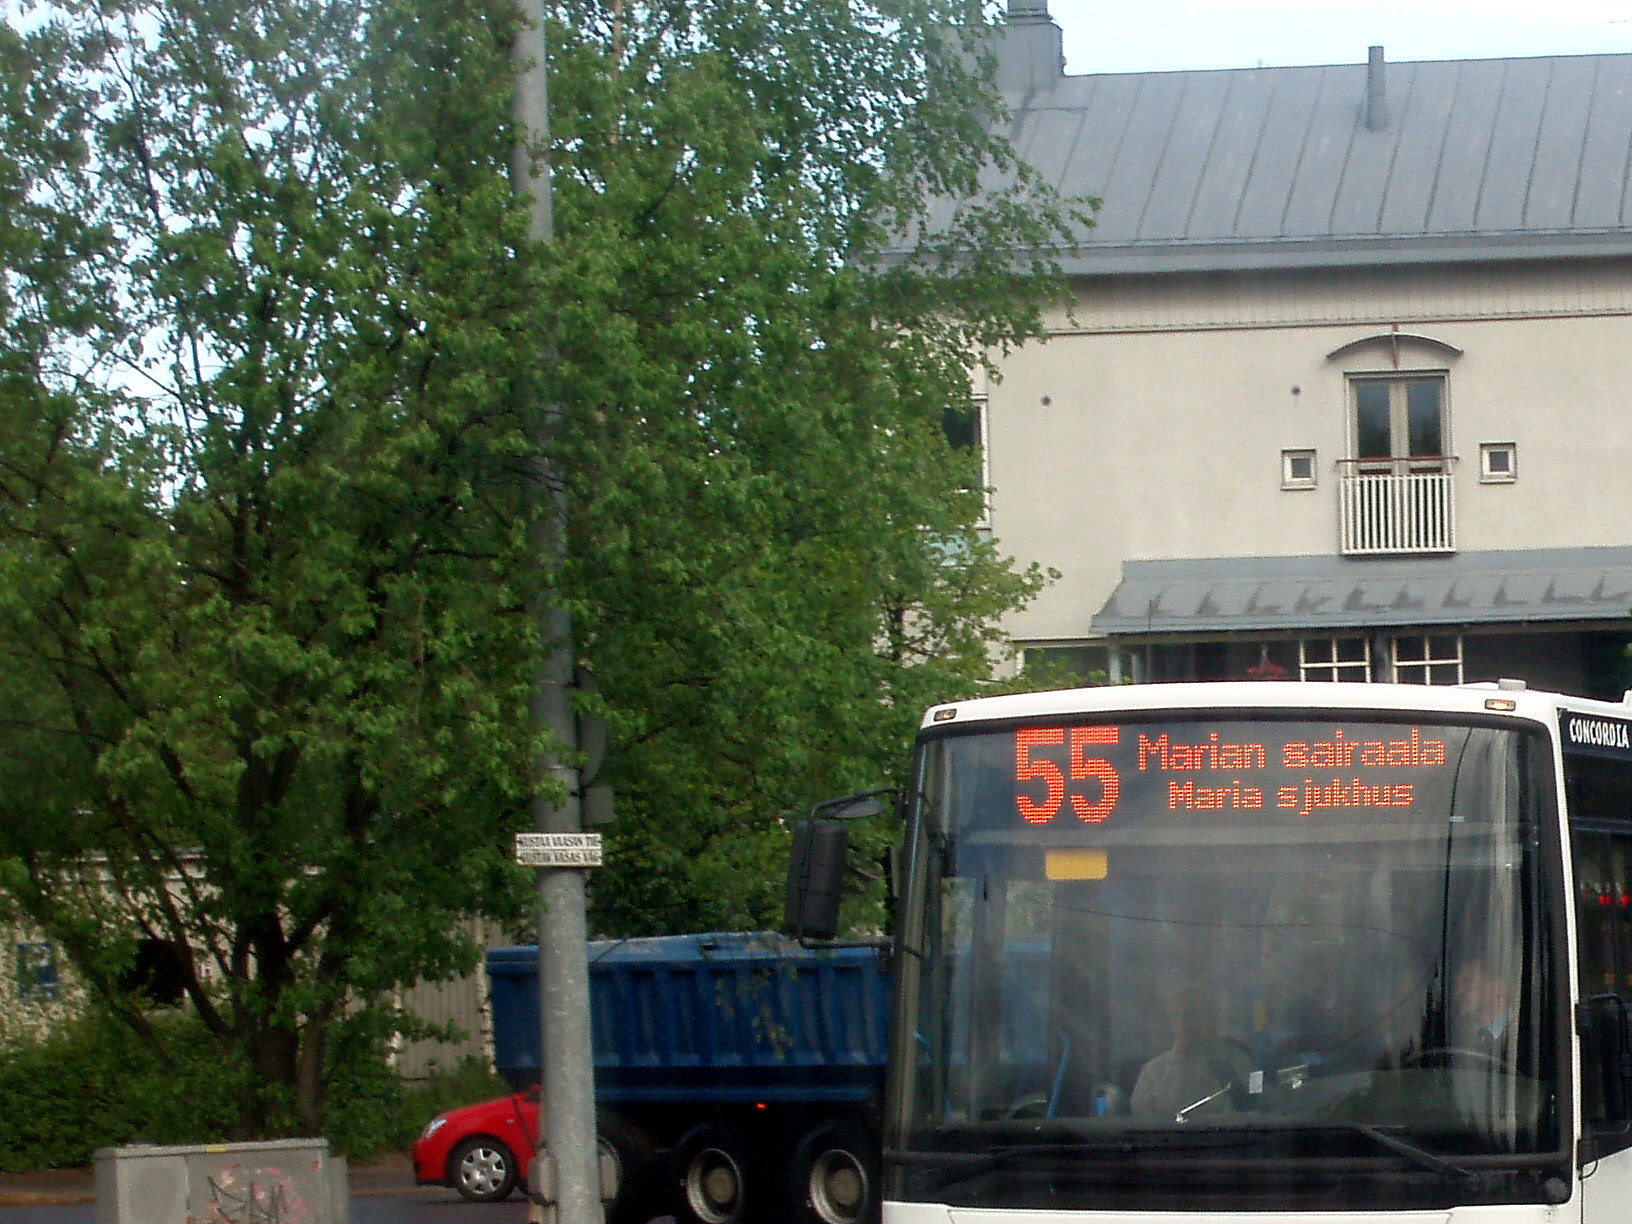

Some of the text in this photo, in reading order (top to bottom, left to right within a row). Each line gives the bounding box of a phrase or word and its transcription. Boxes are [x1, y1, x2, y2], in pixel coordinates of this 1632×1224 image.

[1138, 728, 1446, 771] Marian sairaala
[1569, 718, 1630, 749] CONCORDIA
[1015, 726, 1120, 825] 55
[1168, 776, 1416, 816] Maria sjukhus
